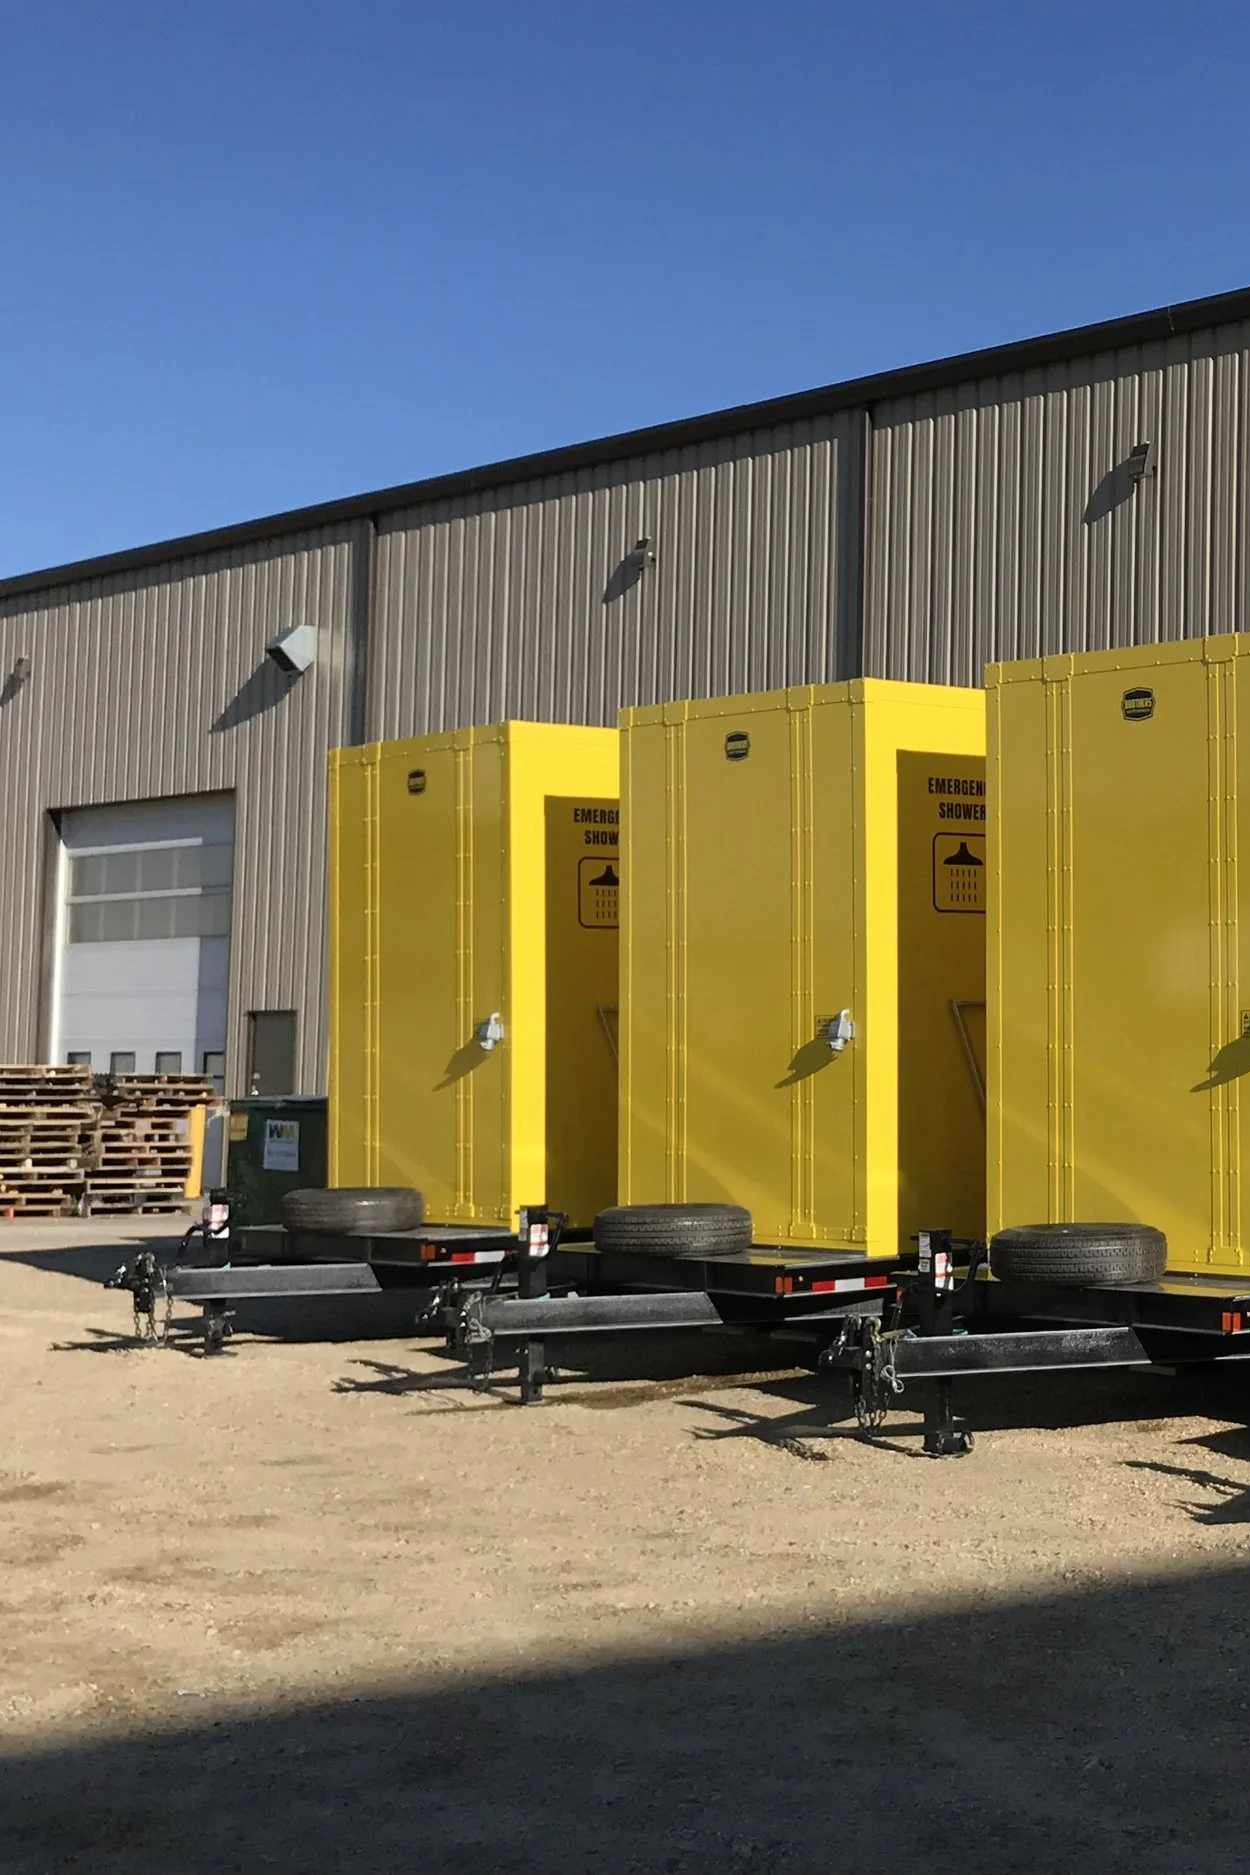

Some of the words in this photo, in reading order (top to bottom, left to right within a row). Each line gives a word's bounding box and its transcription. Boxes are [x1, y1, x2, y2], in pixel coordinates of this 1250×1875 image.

[928, 776, 986, 797] EMERGEN
[939, 802, 986, 820] SHOWER
[584, 829, 619, 846] SHOW
